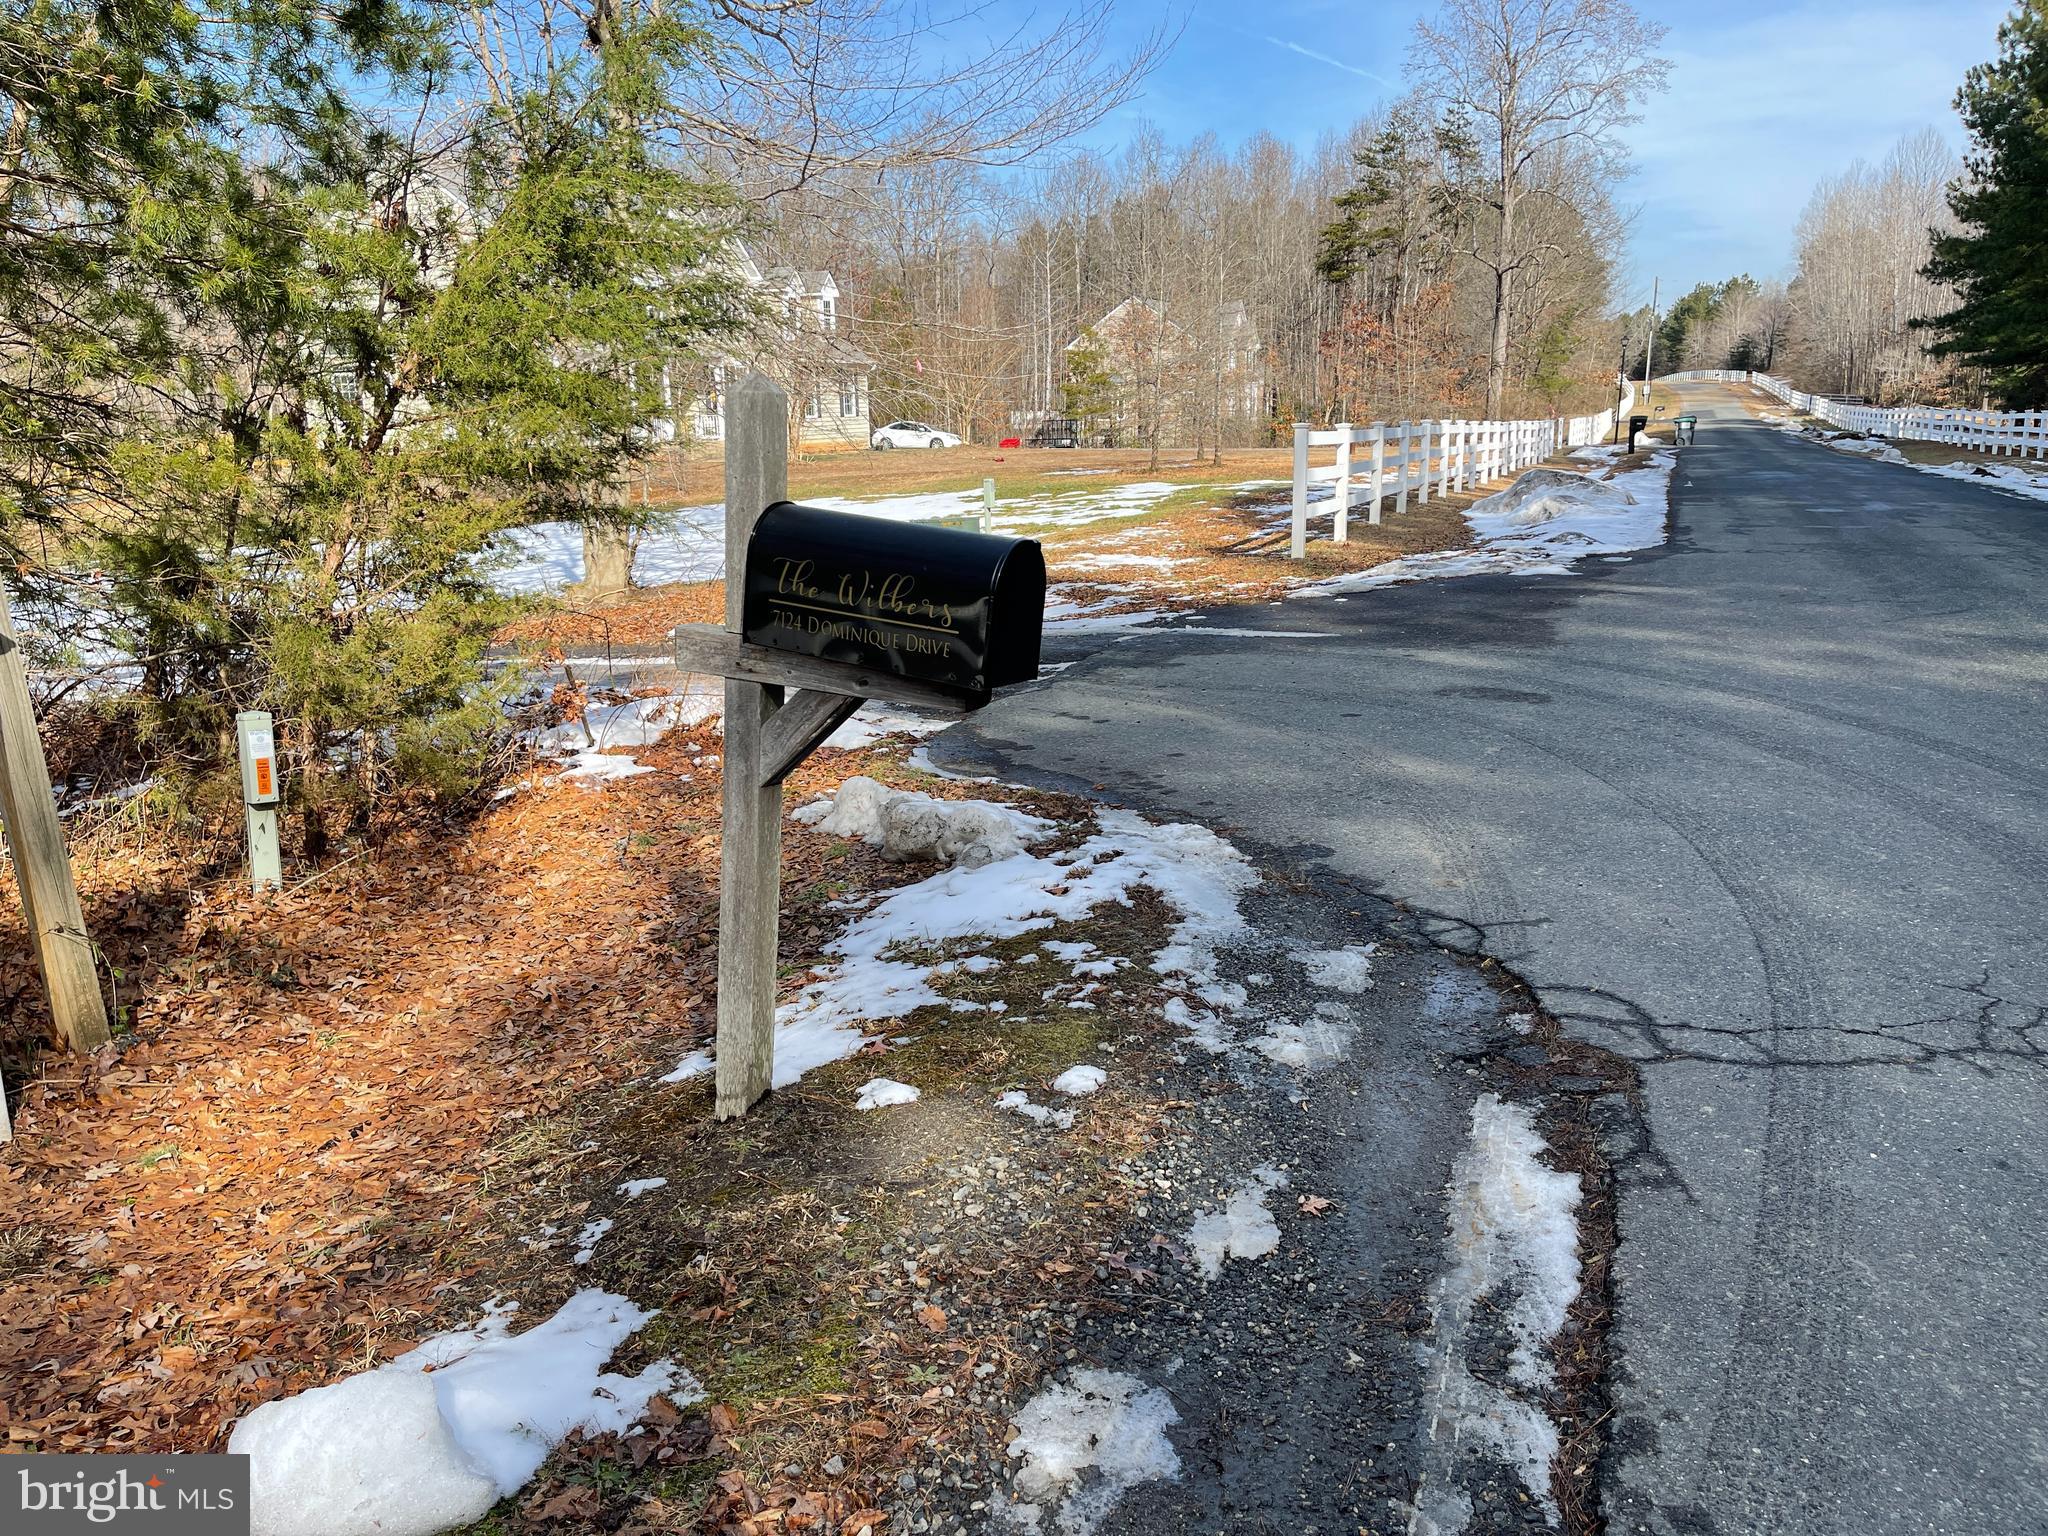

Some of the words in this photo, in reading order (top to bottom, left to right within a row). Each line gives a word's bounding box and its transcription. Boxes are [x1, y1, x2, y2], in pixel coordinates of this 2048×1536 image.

[773, 557, 824, 599] The
[838, 570, 953, 627] Wilbers
[773, 610, 801, 630] 7124
[807, 616, 900, 650] DOMINIQUE
[906, 633, 951, 658] DRIVE
